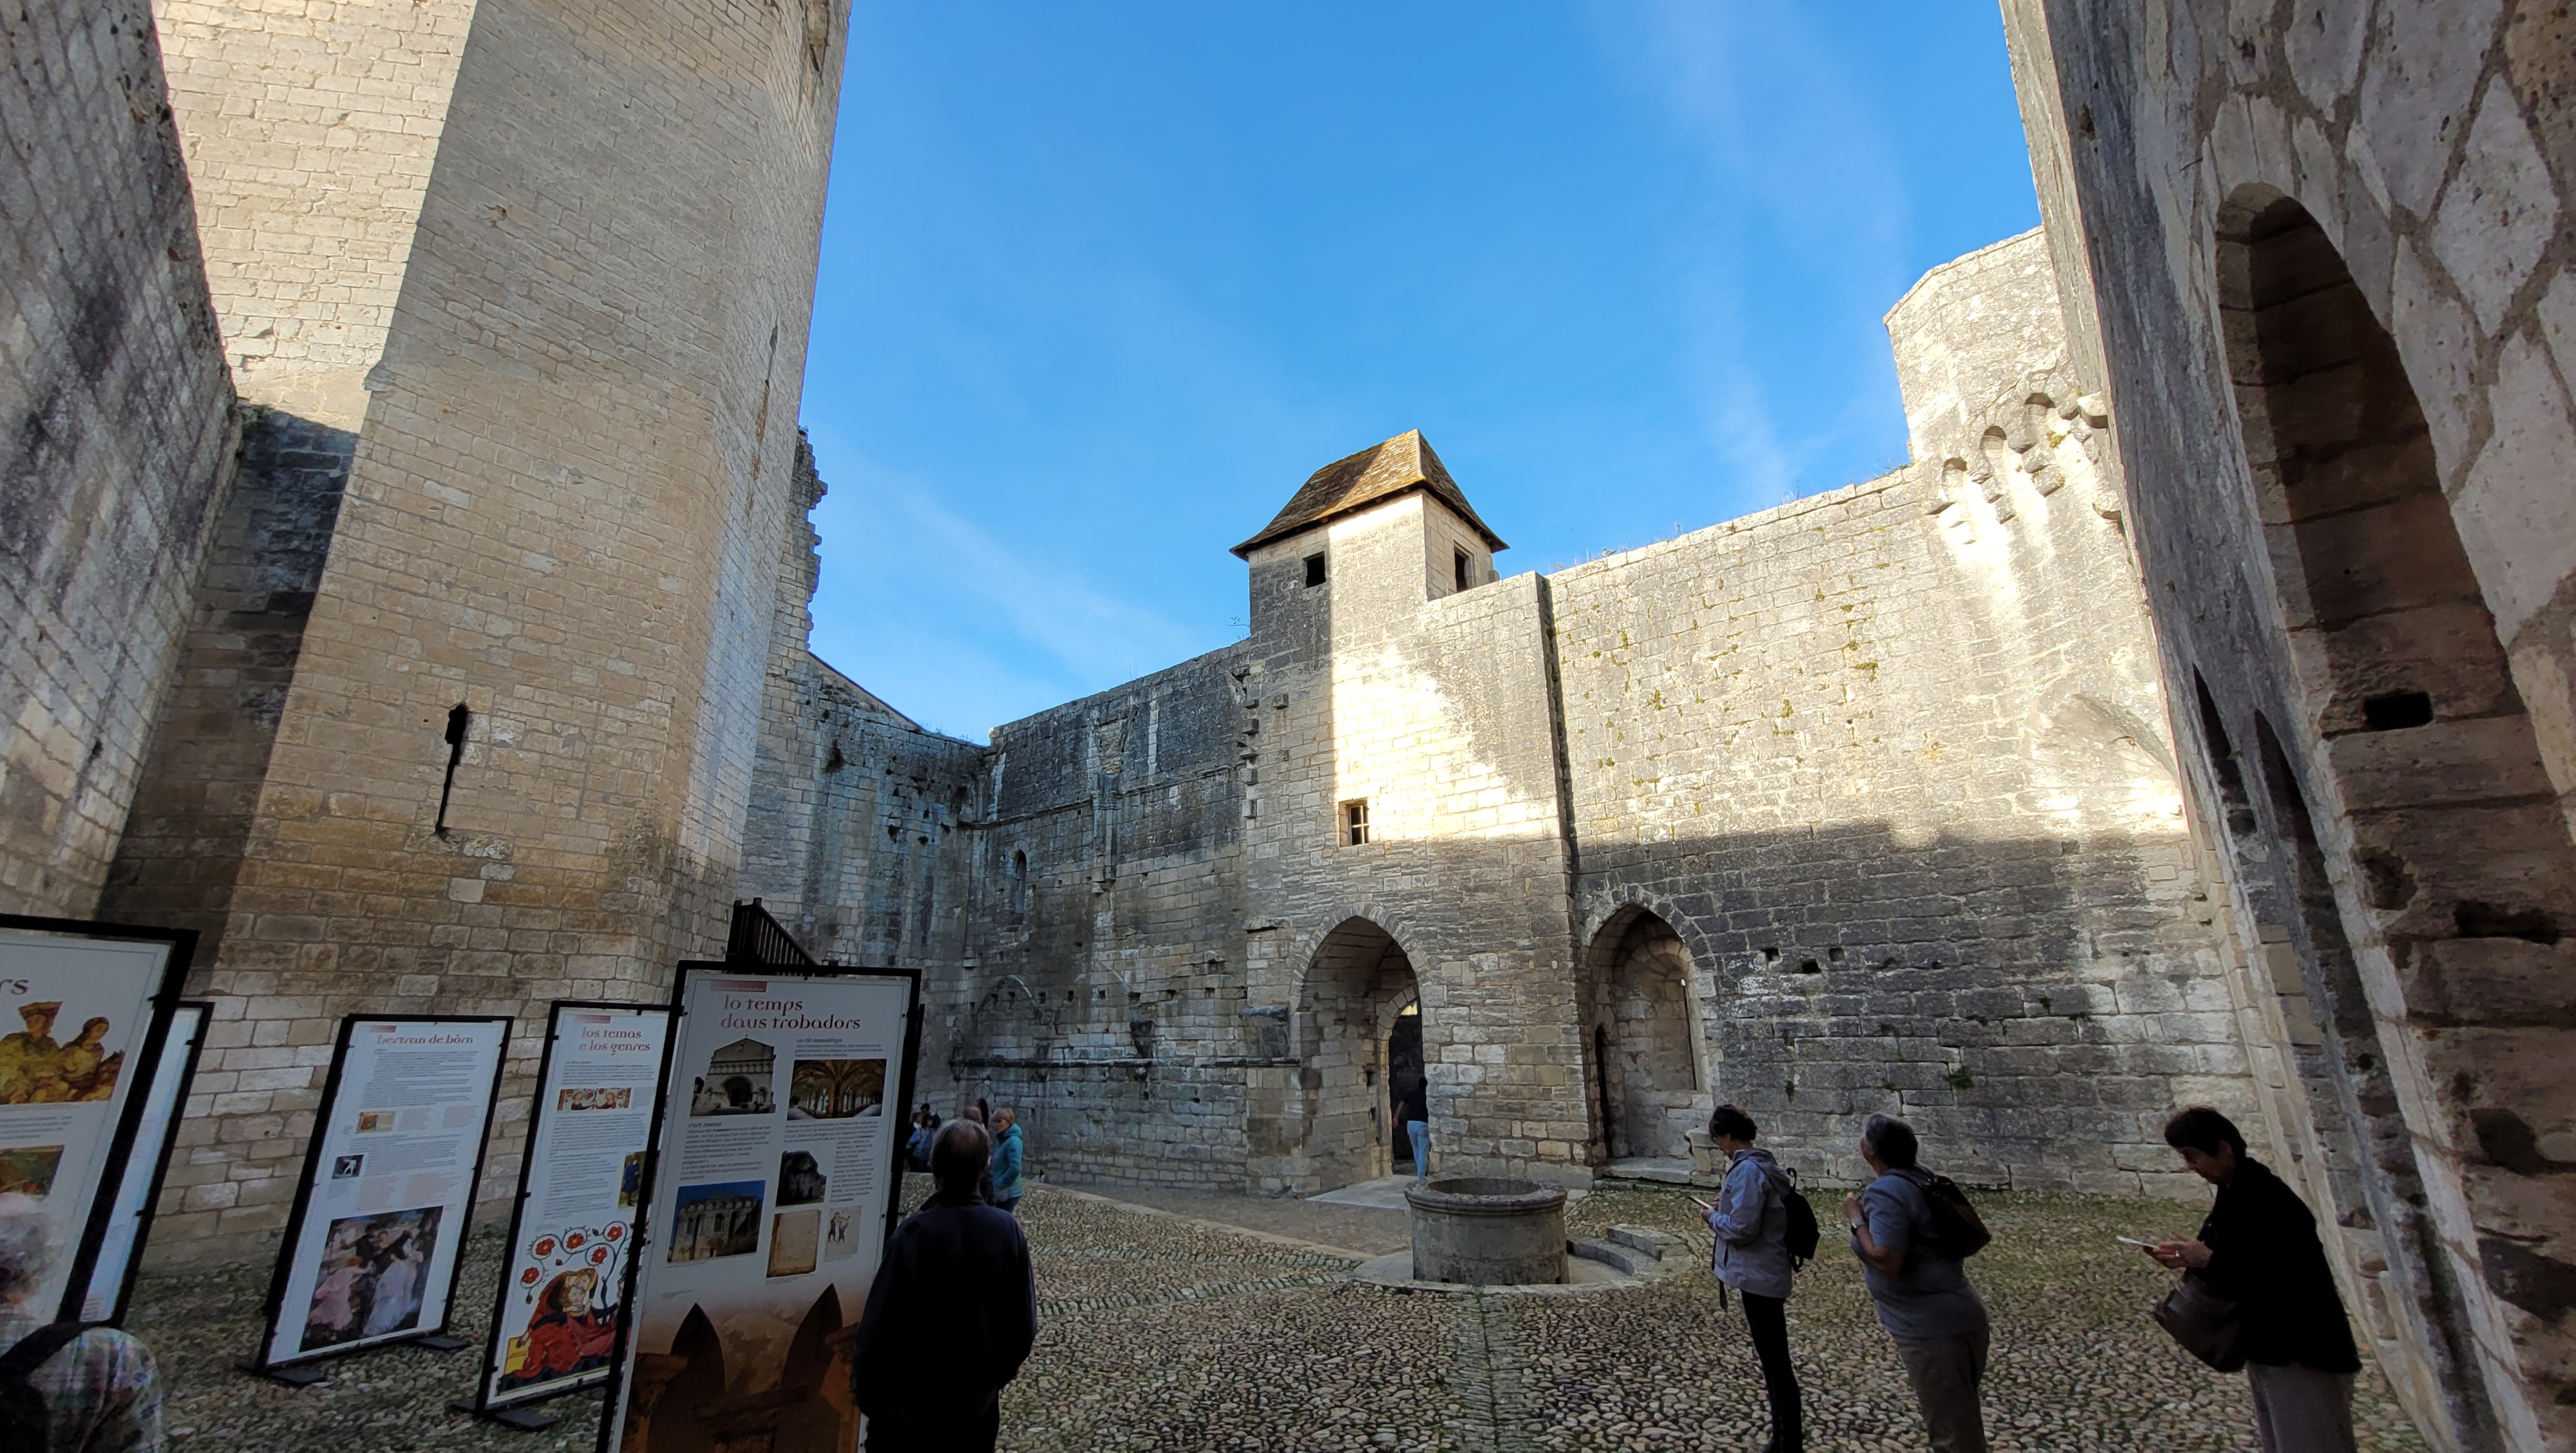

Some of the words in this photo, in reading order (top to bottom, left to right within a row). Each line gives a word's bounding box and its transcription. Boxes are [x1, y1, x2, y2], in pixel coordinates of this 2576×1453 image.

[722, 994, 741, 1011] lo
[746, 997, 803, 1016] temps
[719, 1013, 767, 1029] daus
[771, 1014, 862, 1030] trobadors
[377, 1034, 426, 1045] bertran
[428, 1033, 444, 1044] de
[582, 1026, 600, 1038] los
[603, 1029, 642, 1039] temas
[579, 1042, 587, 1051] e
[589, 1039, 609, 1051] los
[610, 1043, 650, 1056] genres
